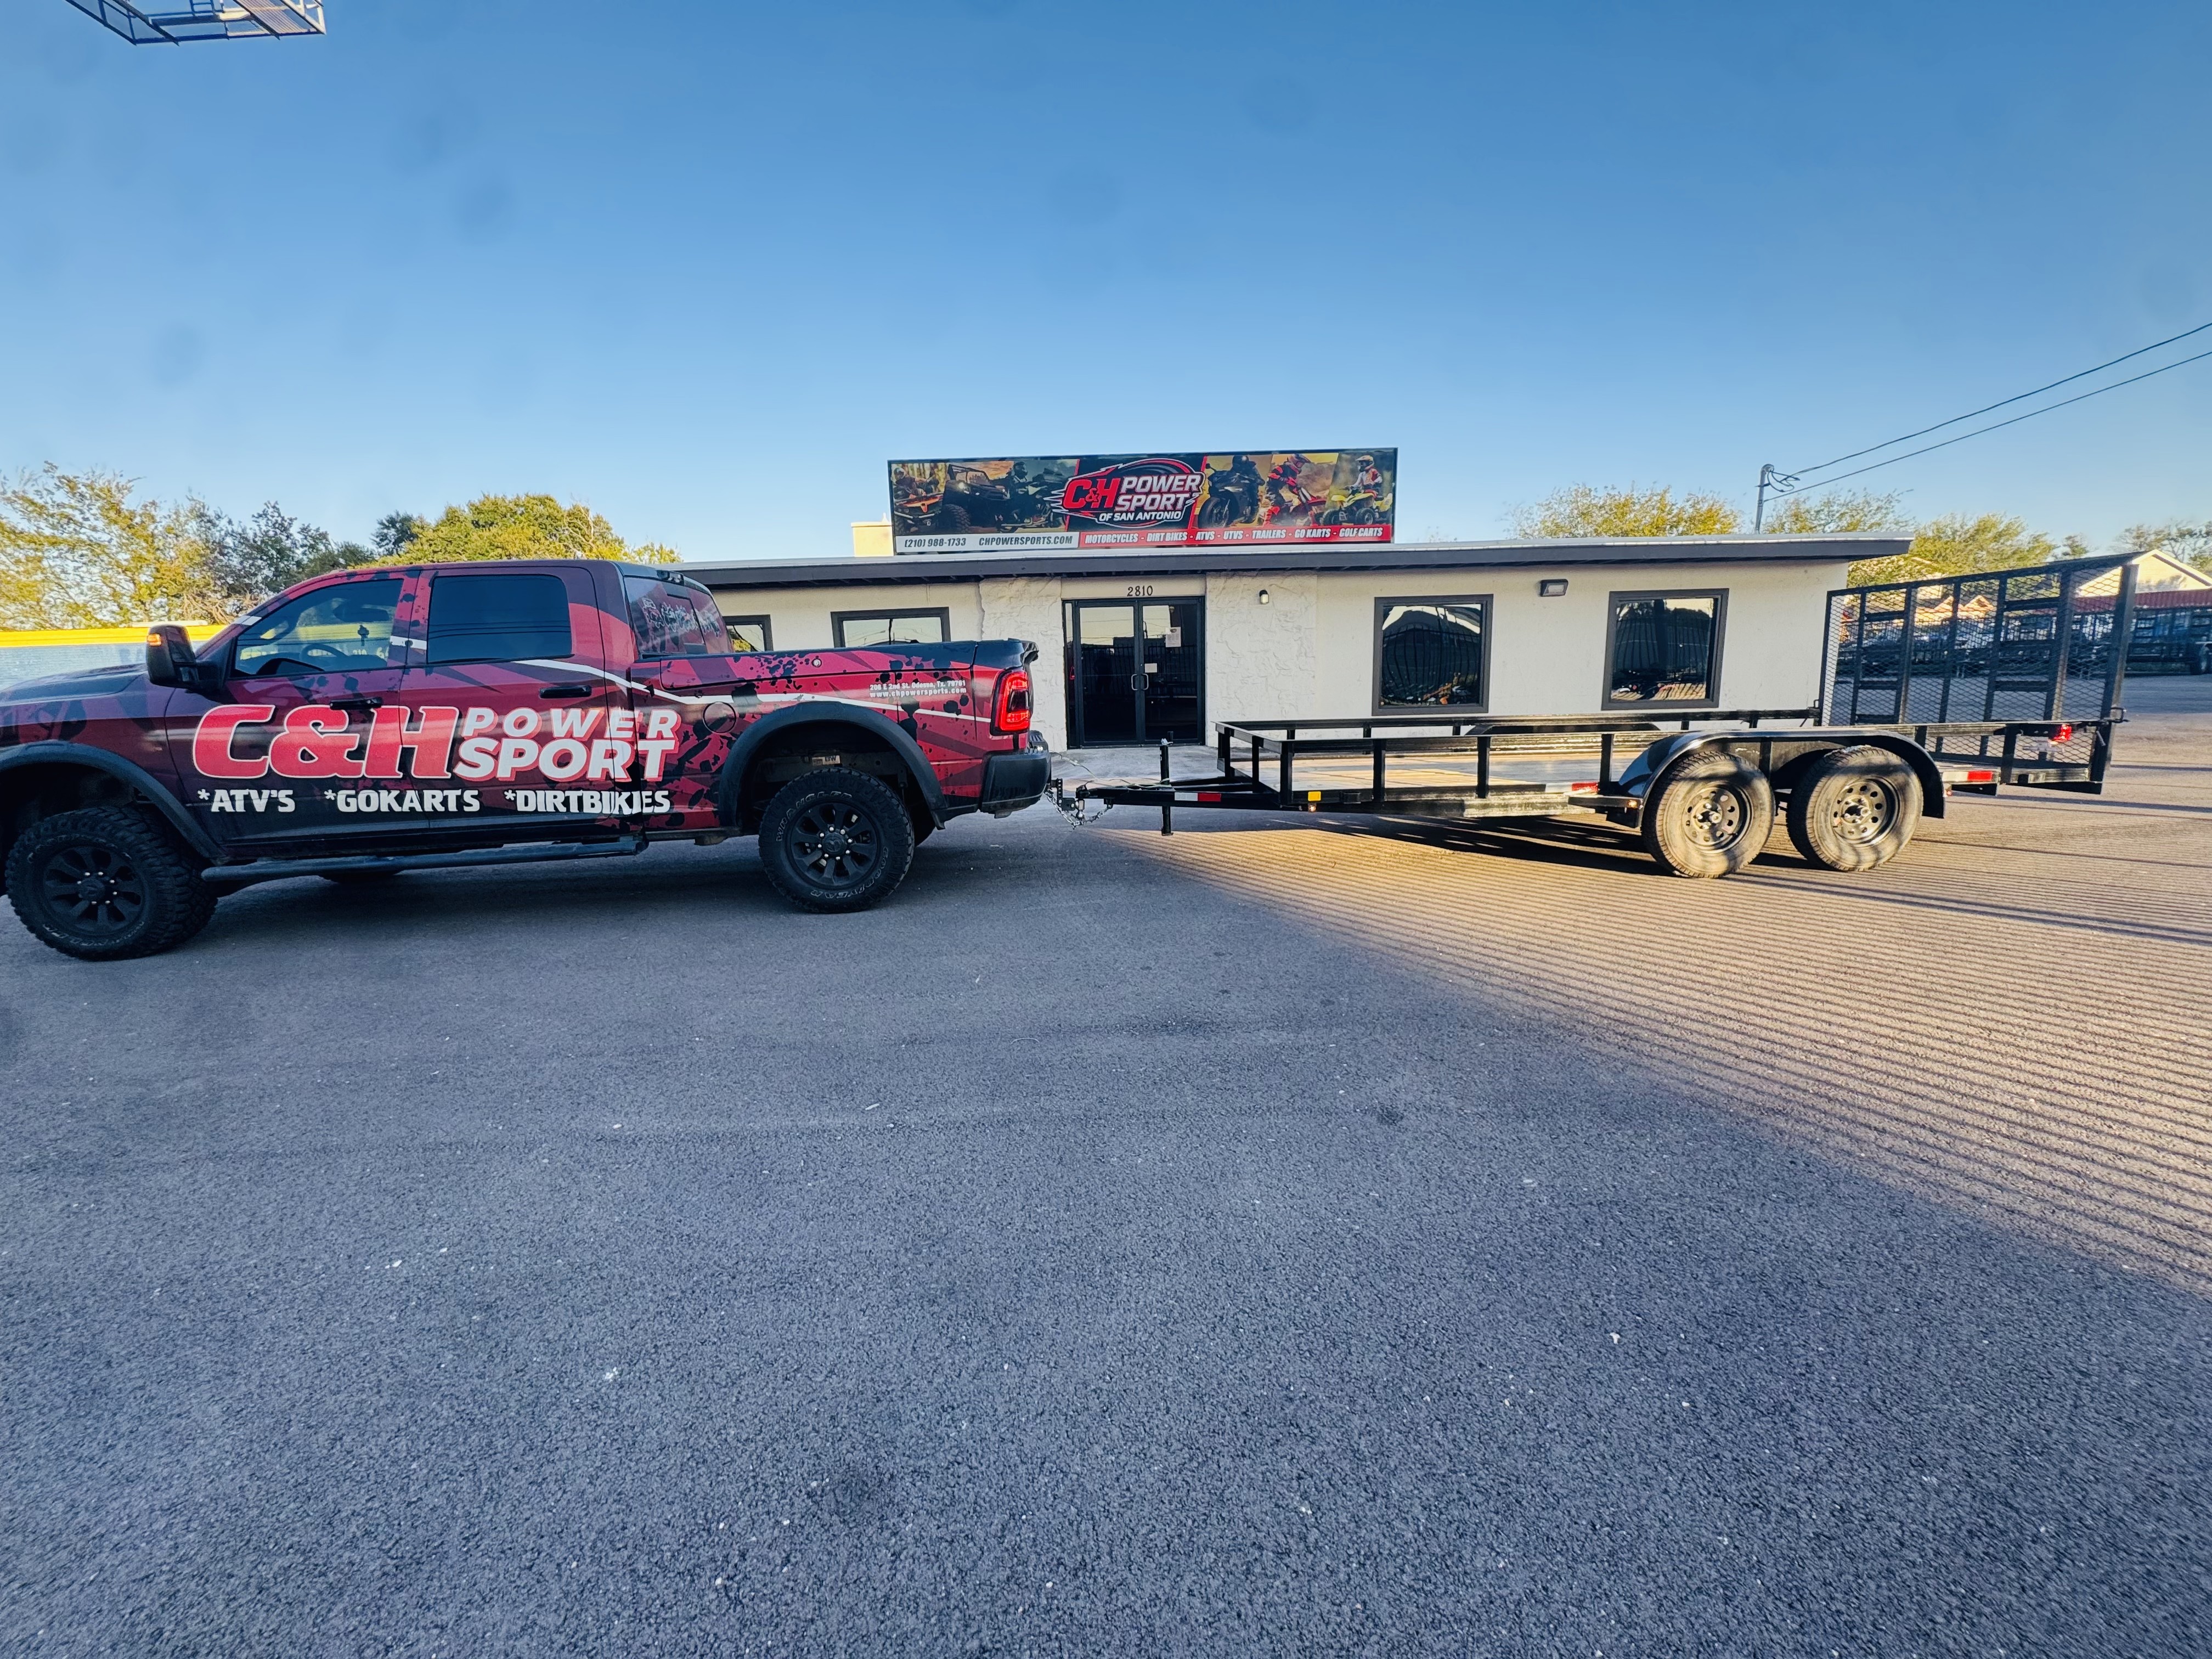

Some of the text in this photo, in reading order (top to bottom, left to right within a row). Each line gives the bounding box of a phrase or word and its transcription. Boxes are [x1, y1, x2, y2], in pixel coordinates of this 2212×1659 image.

[1063, 475, 1201, 509] C&H POWER
[1115, 494, 1190, 511] SPORT
[1099, 511, 1181, 521] OF SAN ANTONIO
[979, 535, 1073, 546] CHPOWERSPORTS.COM
[1085, 533, 1138, 544] MOTORCYCLES
[1147, 533, 1165, 542] DIRT
[1165, 532, 1188, 541] BIKES
[1195, 531, 1215, 541] ATVS
[1223, 531, 1244, 540] UTVS
[1252, 529, 1286, 539] TRAILERS
[1294, 529, 1306, 538] GO
[1305, 528, 1331, 538] KARTS
[1339, 528, 1358, 537] GOLF
[1358, 527, 1383, 537] CARTS
[904, 538, 967, 548] (210) 988-1733
[1126, 585, 1153, 597] 2810
[870, 687, 967, 698] www.chpowersports.com
[192, 704, 681, 779] C&H POWER
[454, 737, 679, 782] SPORT
